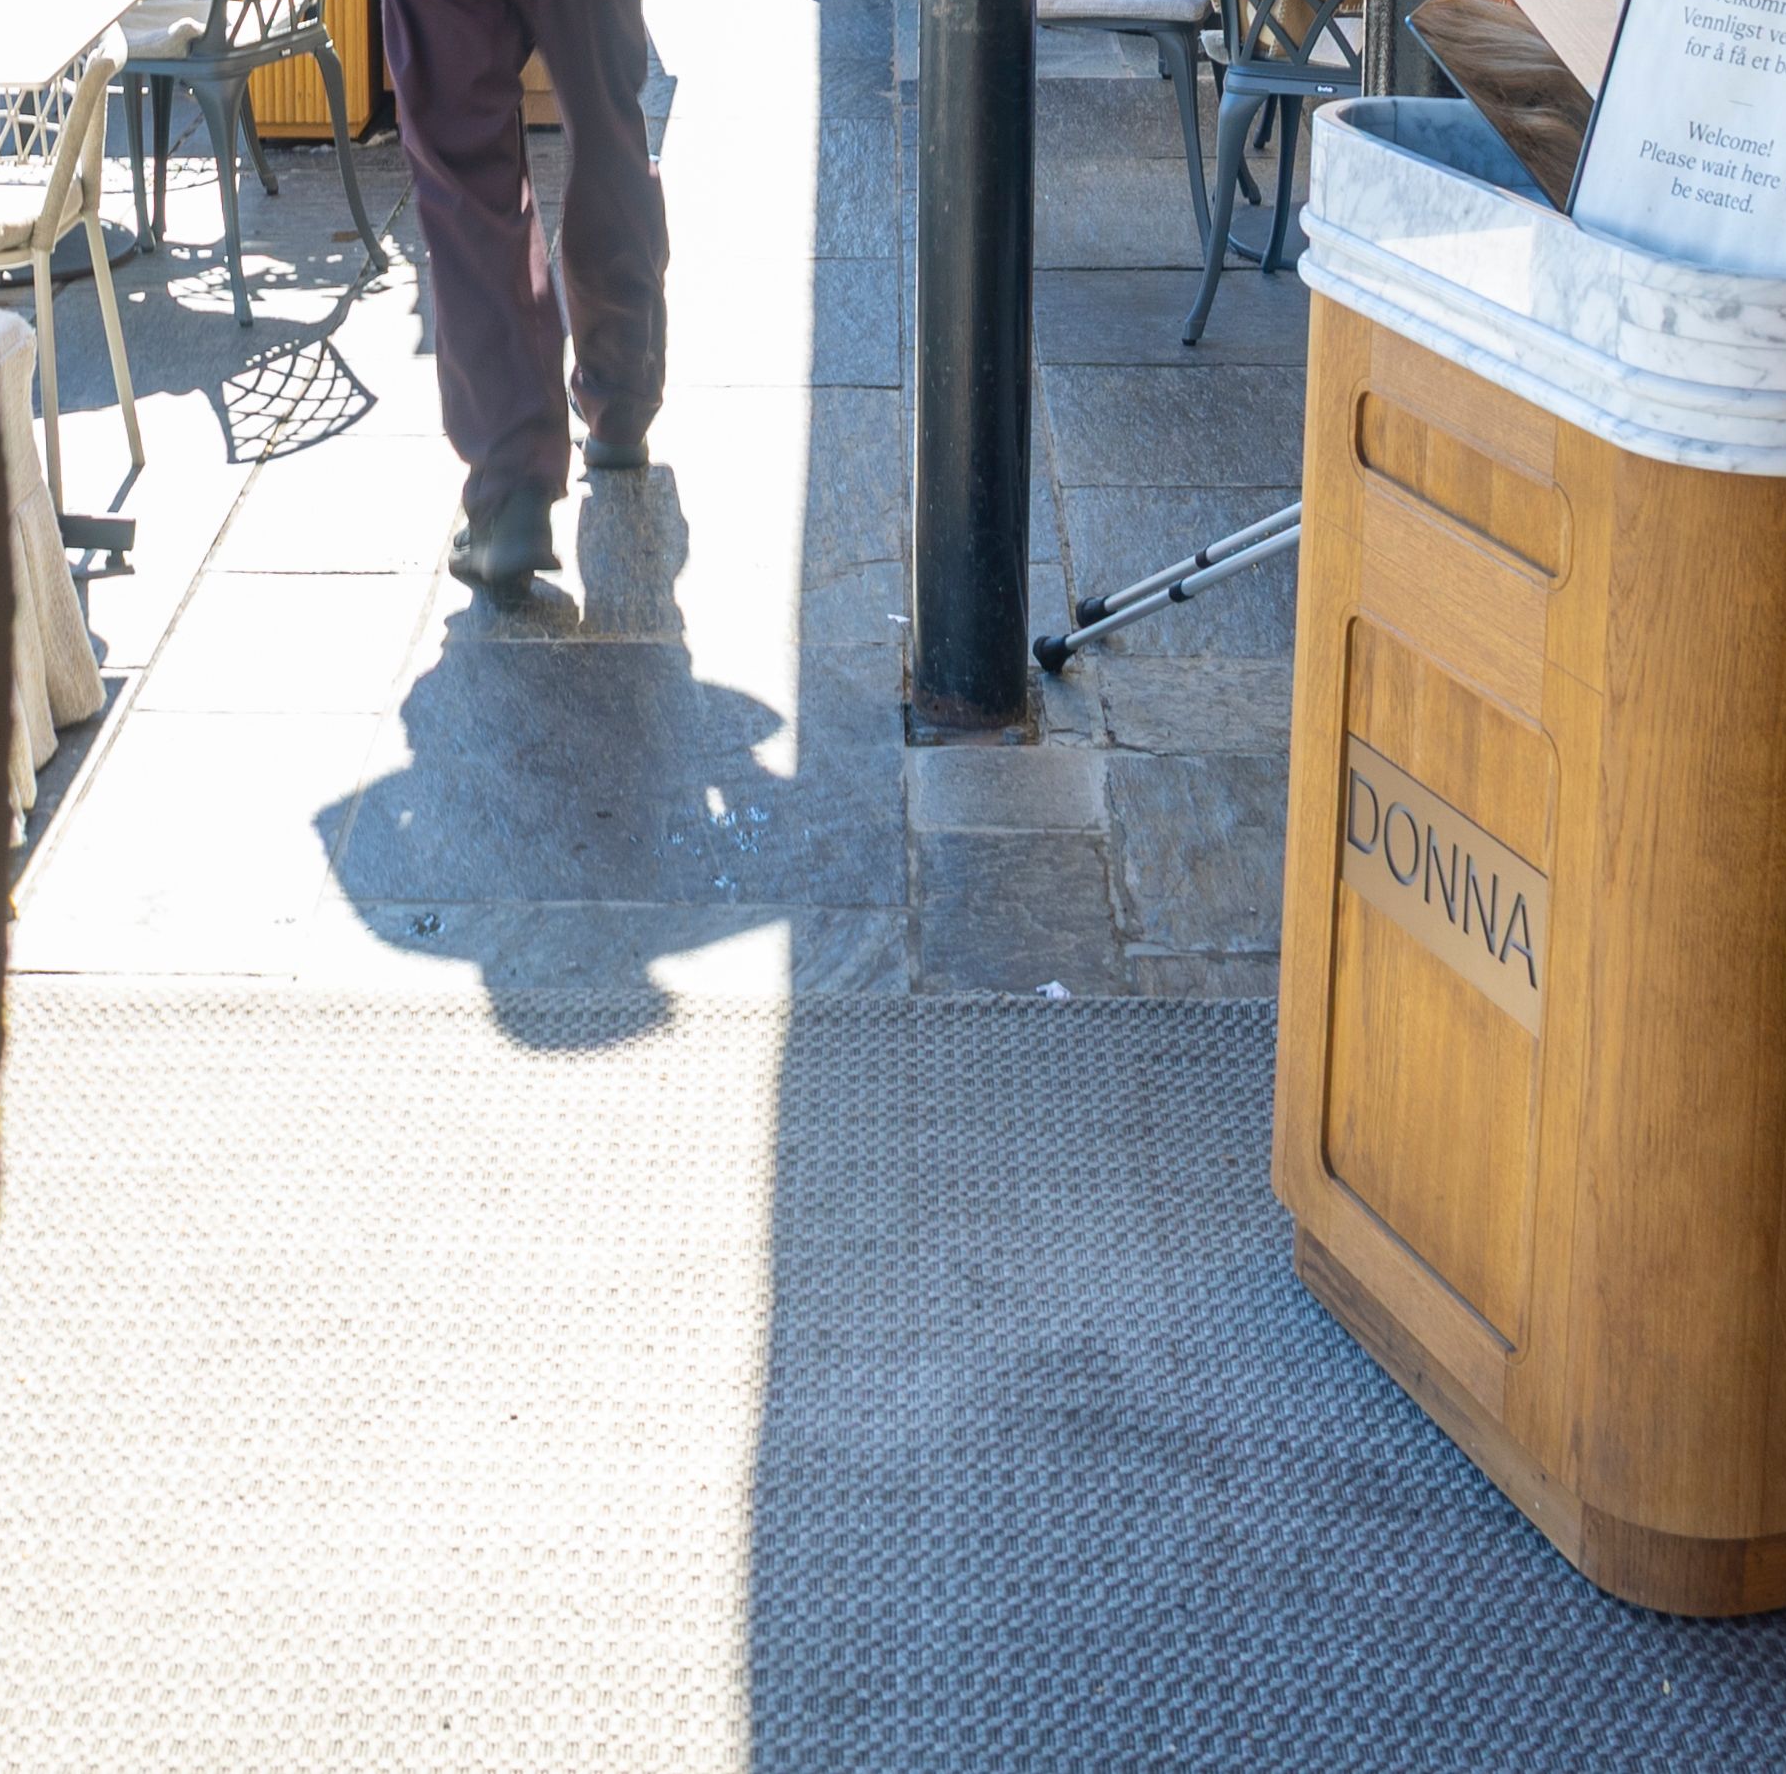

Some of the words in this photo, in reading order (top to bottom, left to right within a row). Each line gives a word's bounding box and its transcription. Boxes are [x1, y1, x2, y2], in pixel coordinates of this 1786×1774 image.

[1683, 6, 1763, 41] Vennligst
[1684, 36, 1712, 58] for
[1713, 42, 1725, 62] å
[1729, 45, 1747, 66] få
[1751, 54, 1771, 71] et
[1688, 120, 1775, 158] Welcome!
[1639, 139, 1697, 170] Please
[1701, 158, 1738, 180] wait
[1740, 163, 1781, 189] here
[1670, 177, 1692, 199] be
[1695, 188, 1754, 214] seated.
[1347, 767, 1537, 990] DONNA
